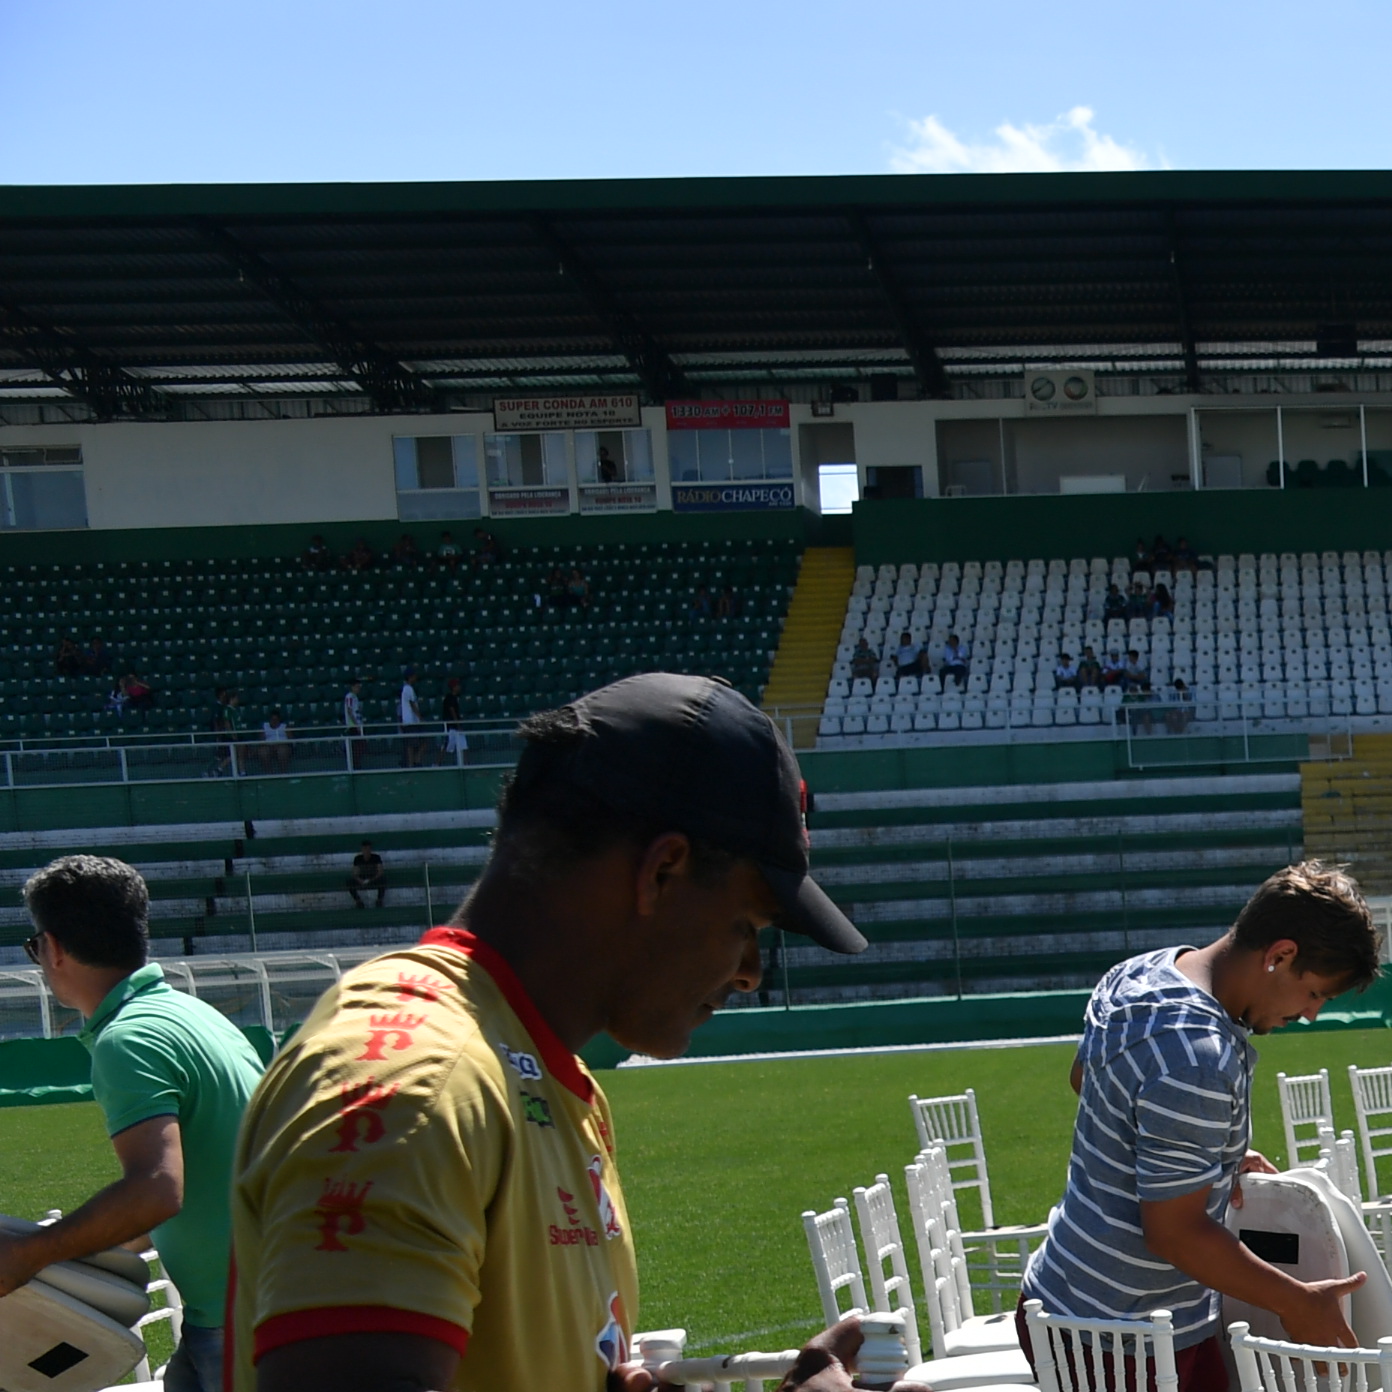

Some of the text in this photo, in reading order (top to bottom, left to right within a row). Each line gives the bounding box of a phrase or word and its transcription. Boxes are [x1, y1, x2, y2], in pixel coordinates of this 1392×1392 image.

[499, 401, 539, 412] SUPER
[589, 398, 608, 408] AM
[611, 397, 633, 408] 610
[519, 412, 563, 420] EQUIPE
[566, 411, 599, 419] NOTA
